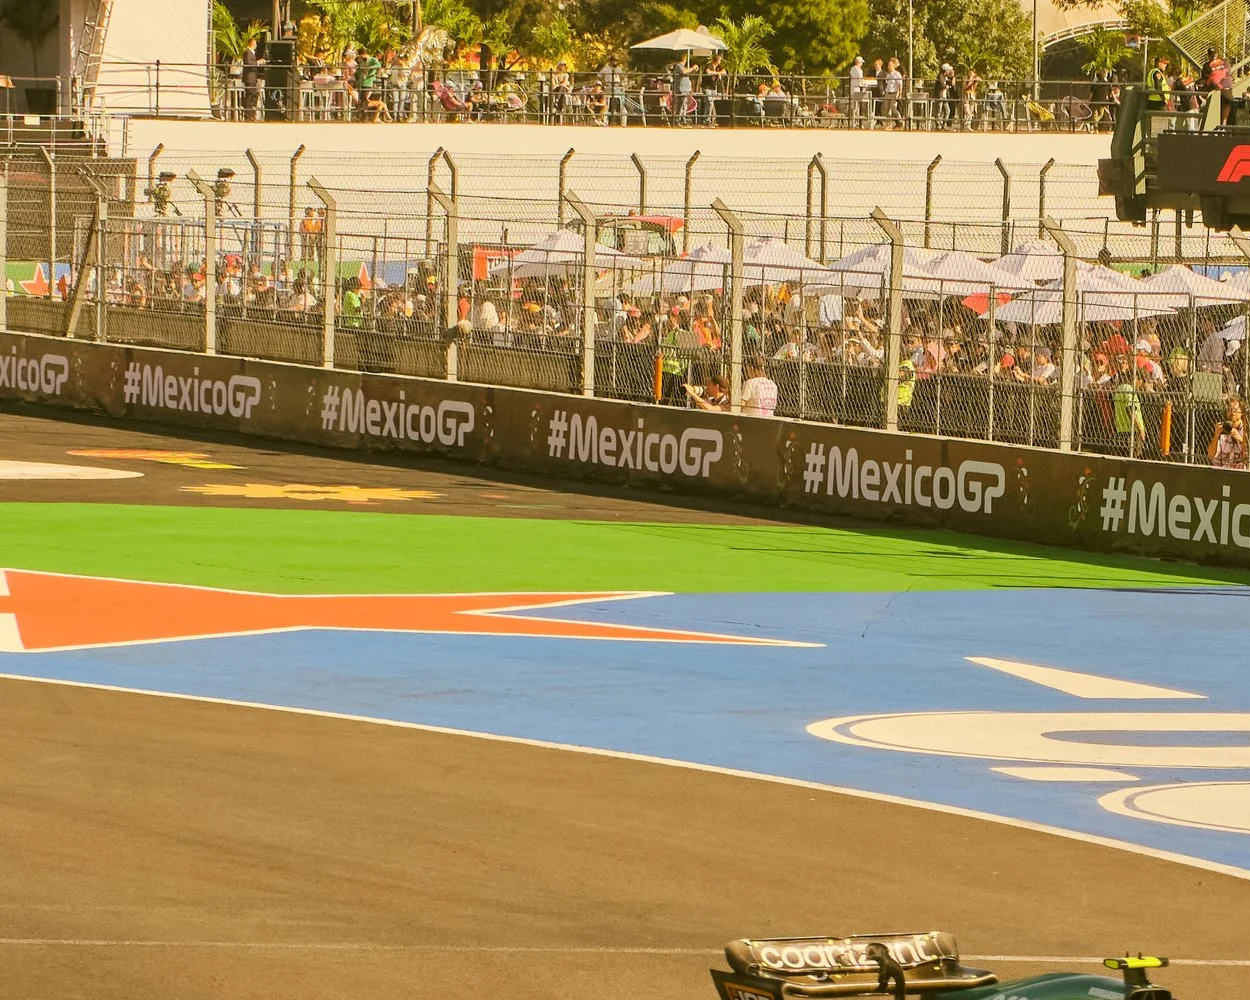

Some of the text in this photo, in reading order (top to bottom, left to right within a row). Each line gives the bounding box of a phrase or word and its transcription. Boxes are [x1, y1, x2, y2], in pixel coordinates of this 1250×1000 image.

[123, 361, 262, 419] #MexicoGP
[321, 385, 476, 447] #MexicoGP
[547, 409, 724, 478] #MexicoGP
[803, 442, 1006, 514] #MexicoGP
